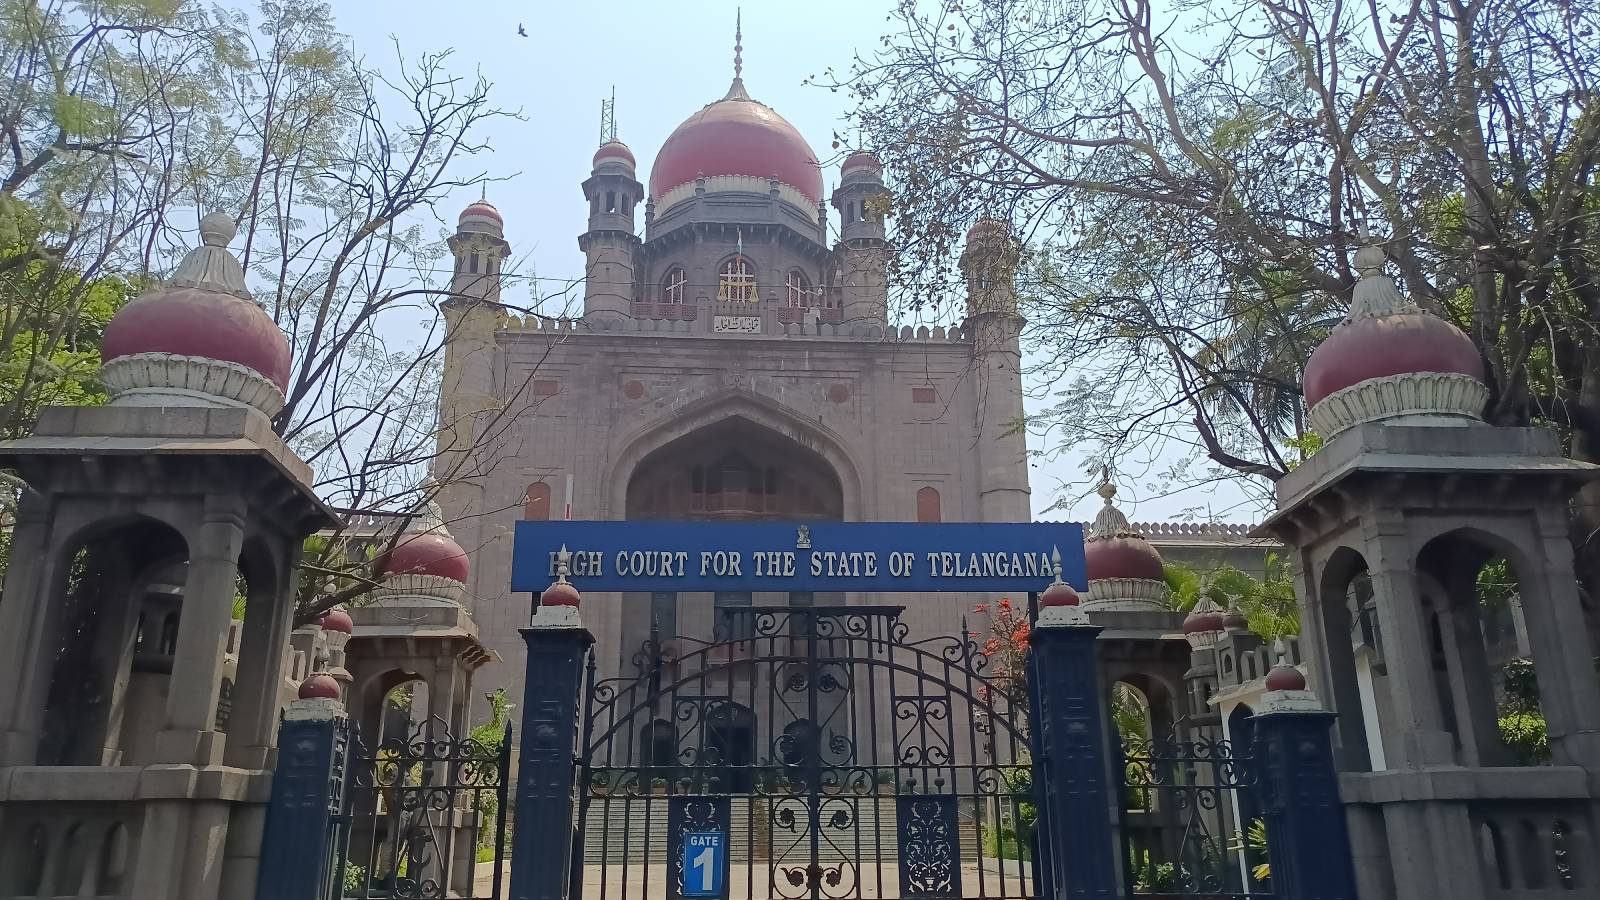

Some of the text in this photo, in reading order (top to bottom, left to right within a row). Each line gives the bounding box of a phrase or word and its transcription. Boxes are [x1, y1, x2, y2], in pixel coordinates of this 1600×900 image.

[615, 551, 688, 577] COURT
[700, 551, 742, 577] FOR
[753, 551, 795, 577] THE
[811, 551, 877, 577] STATE
[888, 551, 915, 577] OF
[927, 552, 1054, 577] TELANGANA
[690, 836, 719, 846] GATE
[693, 847, 714, 891] 1
